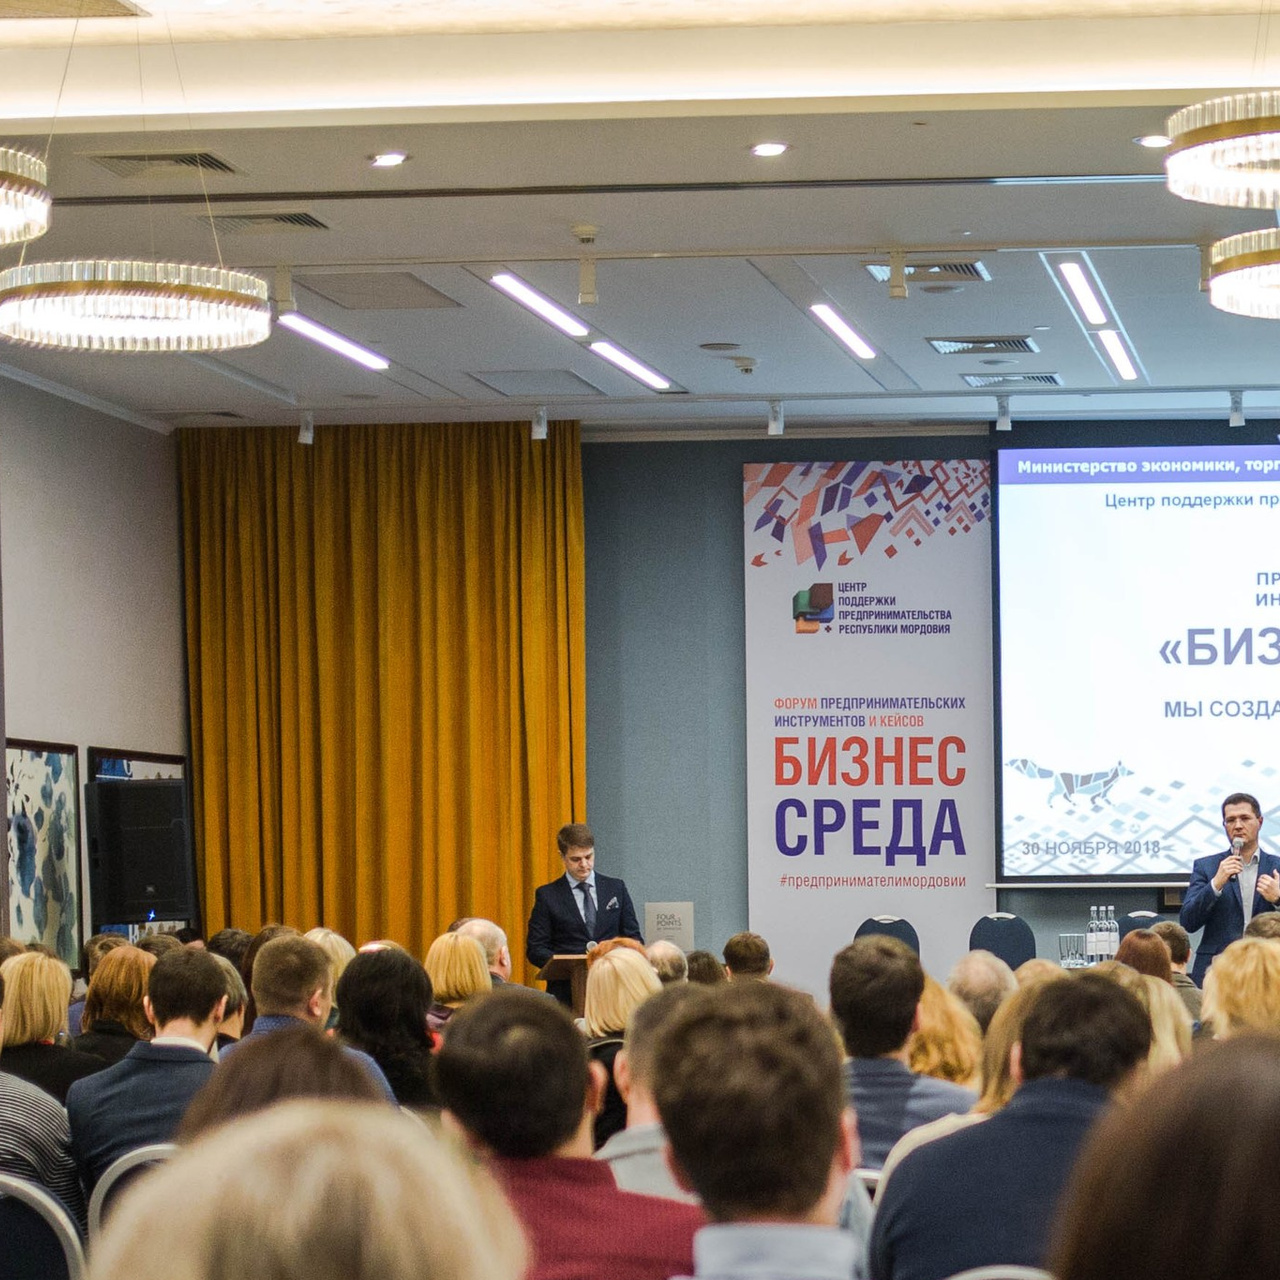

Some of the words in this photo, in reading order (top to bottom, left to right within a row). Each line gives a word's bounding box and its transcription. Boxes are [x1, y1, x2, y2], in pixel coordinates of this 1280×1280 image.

[1017, 460, 1137, 475] Министерство
[1141, 460, 1241, 473] экономики,
[1105, 494, 1155, 509] Центр
[1161, 495, 1253, 508] поддержки
[838, 582, 867, 593] ЦЕНТР
[838, 596, 896, 607] ПОДДЕРЖКИ
[838, 610, 952, 621] ПРЕДПРИНИМАТЕЛЬСТВА
[839, 624, 898, 634] РЕСПУБЛИКИ
[900, 624, 951, 635] МОРДОВИЯ
[774, 697, 817, 709] ФОРУМ
[820, 697, 966, 711] ПРЕДПРИНИМАТЕЛЬСКИХ
[1164, 700, 1203, 718] МЫ
[774, 715, 866, 727] ИНСТРУМЕНТОВ
[869, 715, 877, 727] И
[880, 713, 924, 727] КЕЙСОВ
[774, 736, 967, 787] БИЗНЕС
[774, 798, 967, 867] СРЕДА
[1022, 842, 1040, 855] 30
[1045, 841, 1119, 855] НОЯБРЯ
[1124, 840, 1161, 854] 2018
[779, 873, 966, 890] #предпринимателимордовии
